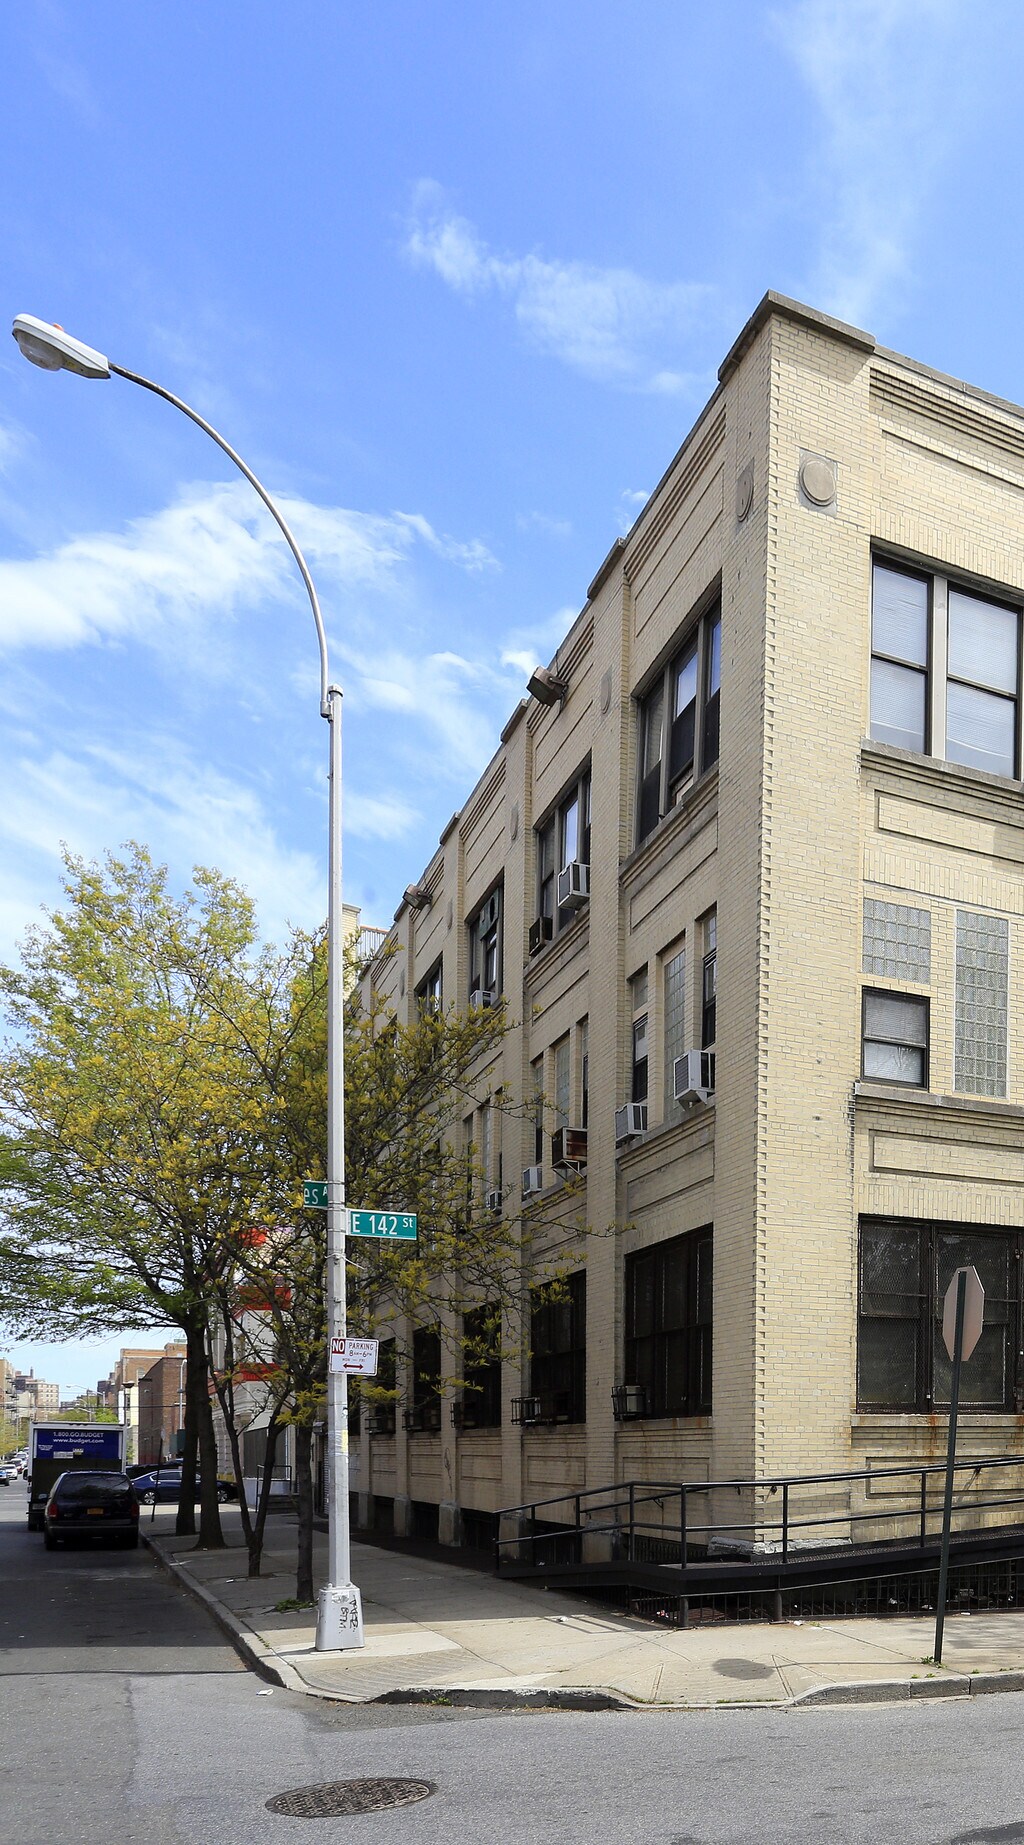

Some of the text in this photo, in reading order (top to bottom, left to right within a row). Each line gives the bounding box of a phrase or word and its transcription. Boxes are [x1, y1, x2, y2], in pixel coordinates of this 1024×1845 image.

[352, 1214, 413, 1235] E 142 St
[332, 1340, 374, 1352] NO PARKING
